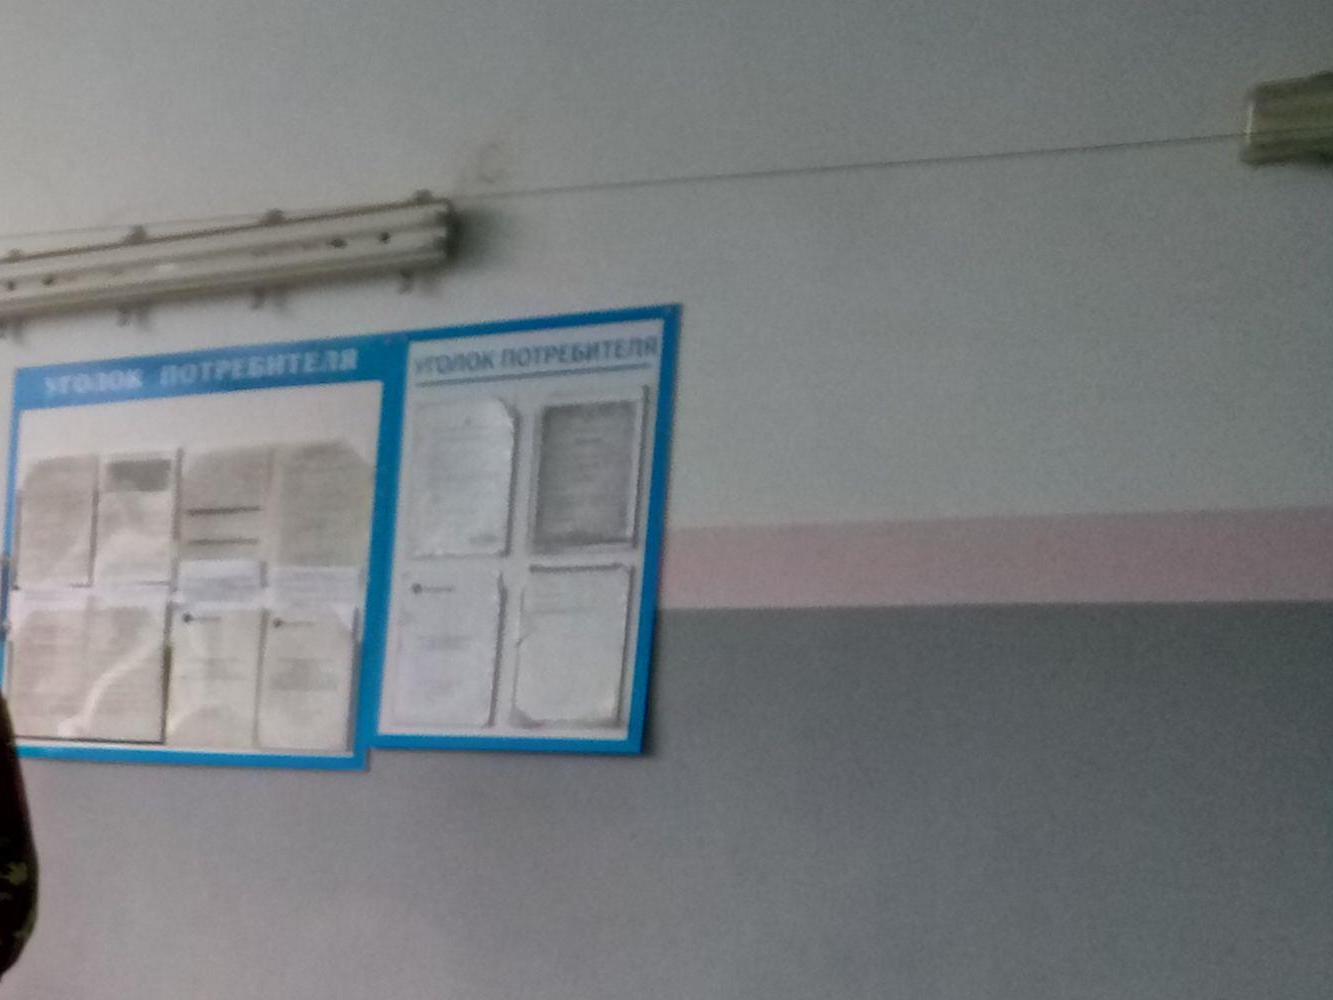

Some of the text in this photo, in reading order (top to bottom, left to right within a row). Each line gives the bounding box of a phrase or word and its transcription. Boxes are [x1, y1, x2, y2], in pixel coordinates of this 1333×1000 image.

[44, 348, 358, 396] УГОЛОК ПОТРЕБИТЕЛЯ
[414, 334, 659, 375] УГОЛОК ПОТРЕБИТЕЛЯ
